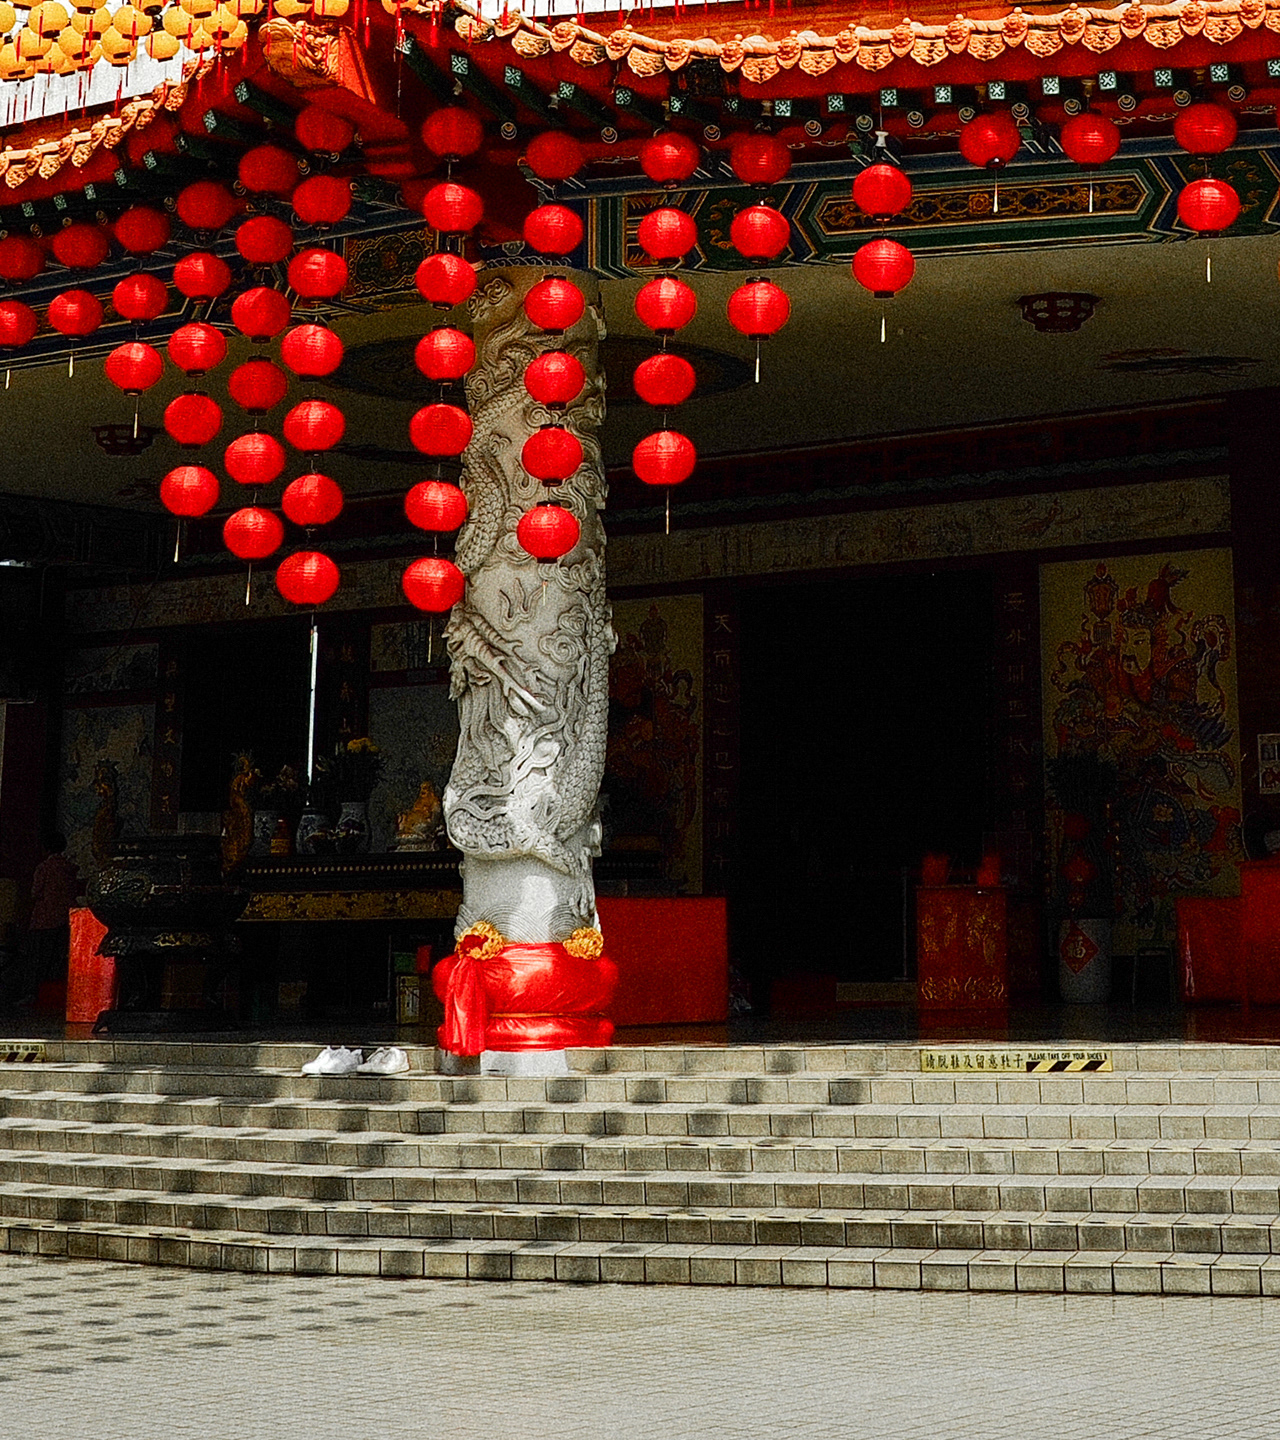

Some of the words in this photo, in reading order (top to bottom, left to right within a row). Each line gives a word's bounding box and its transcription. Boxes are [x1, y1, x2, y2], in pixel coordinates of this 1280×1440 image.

[1028, 1052, 1046, 1061] PLEASE
[1048, 1052, 1060, 1061] TAKE
[1061, 1052, 1071, 1060] OFF
[1072, 1052, 1085, 1060] YOUR
